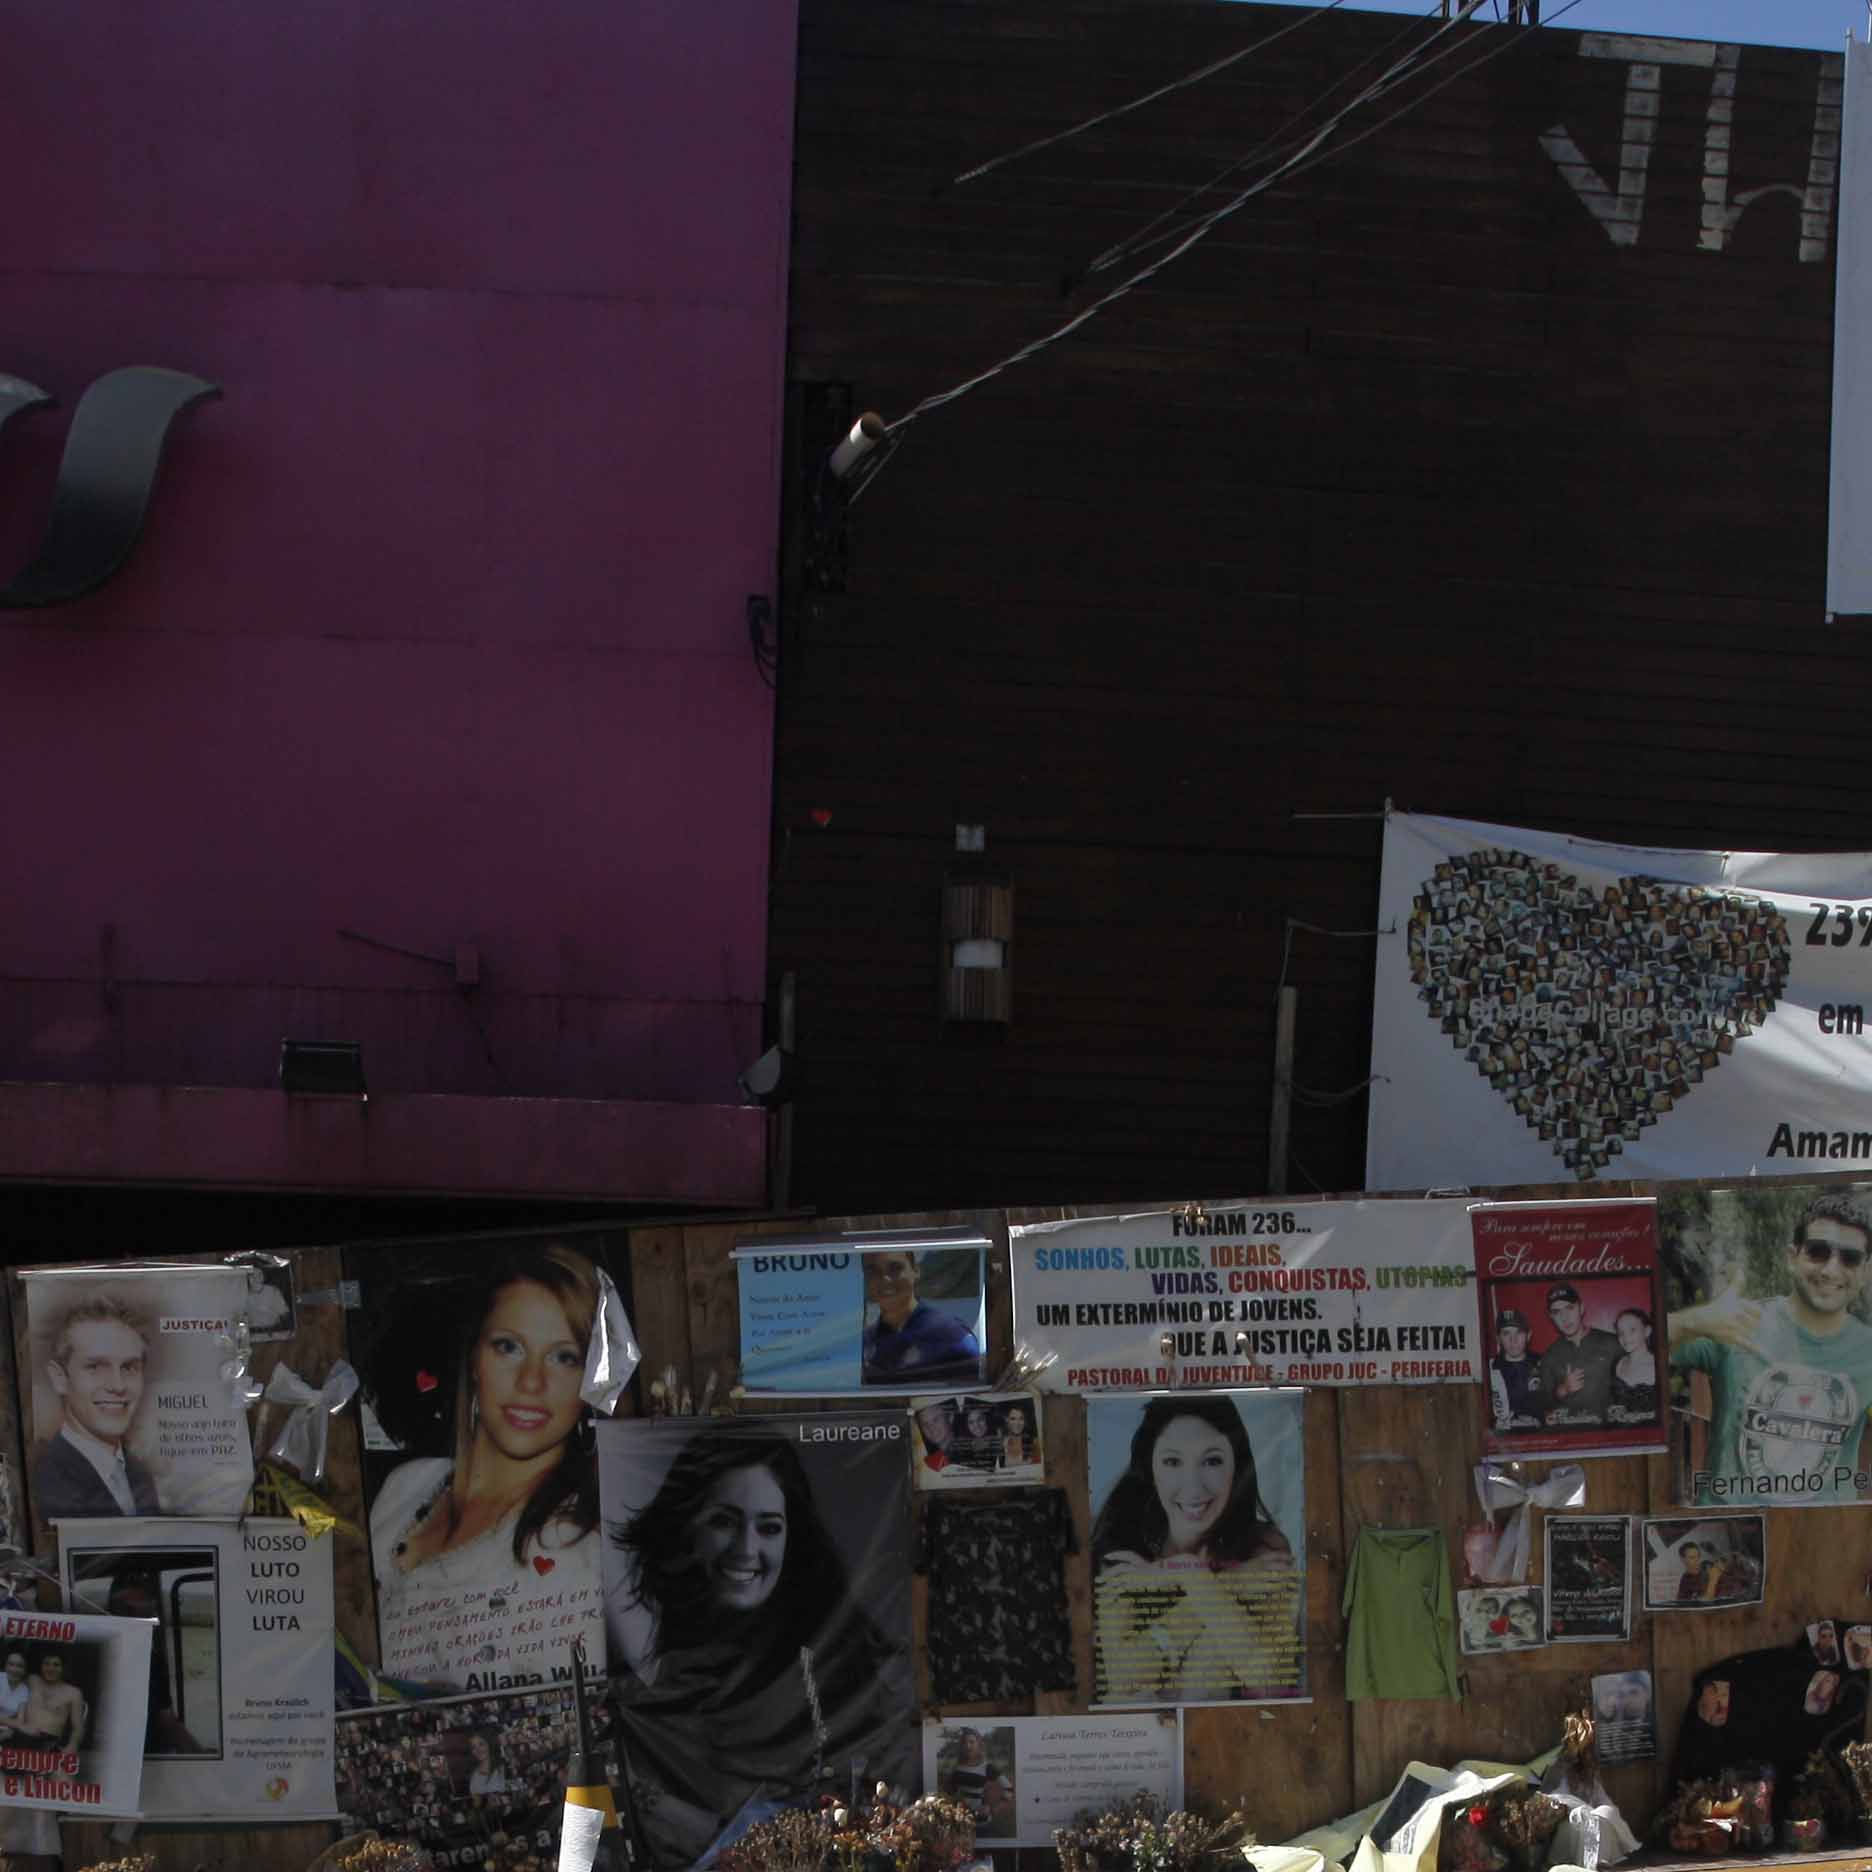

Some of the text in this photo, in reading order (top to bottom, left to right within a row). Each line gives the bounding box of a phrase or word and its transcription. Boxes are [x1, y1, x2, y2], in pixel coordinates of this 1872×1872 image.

[1818, 1001, 1863, 1035] em
[1172, 1211, 1312, 1237] FORAM 236...
[753, 1253, 850, 1273] BRUNO
[1035, 1244, 1286, 1271] SONHOS, LUTAS, IDEAIS,
[1489, 1241, 1650, 1277] Saudades...
[1152, 1264, 1468, 1296] VIDAS, CONQUISTAS, UTOPIAS
[1037, 1297, 1323, 1326] UM EXTERMÍNIO DE JOVENS.
[1337, 1326, 1391, 1353] SEJA
[1397, 1326, 1466, 1351] FEITA!
[1068, 1367, 1151, 1387] PASTORAL
[1288, 1363, 1344, 1381] GRUPO
[1348, 1361, 1376, 1380] JUC
[1392, 1360, 1471, 1378] PERIFERIA
[158, 1393, 209, 1409] MIGUEL
[799, 1423, 902, 1444] Laureane
[1694, 1468, 1824, 1497] Fernando
[242, 1534, 307, 1552] NOSSO
[250, 1562, 300, 1579] LUTO
[246, 1588, 305, 1605] VIROU
[6, 1617, 77, 1642] ETERNO
[252, 1615, 301, 1632] LUTA
[466, 1670, 543, 1691] Allana
[24, 1774, 102, 1804] Lincon
